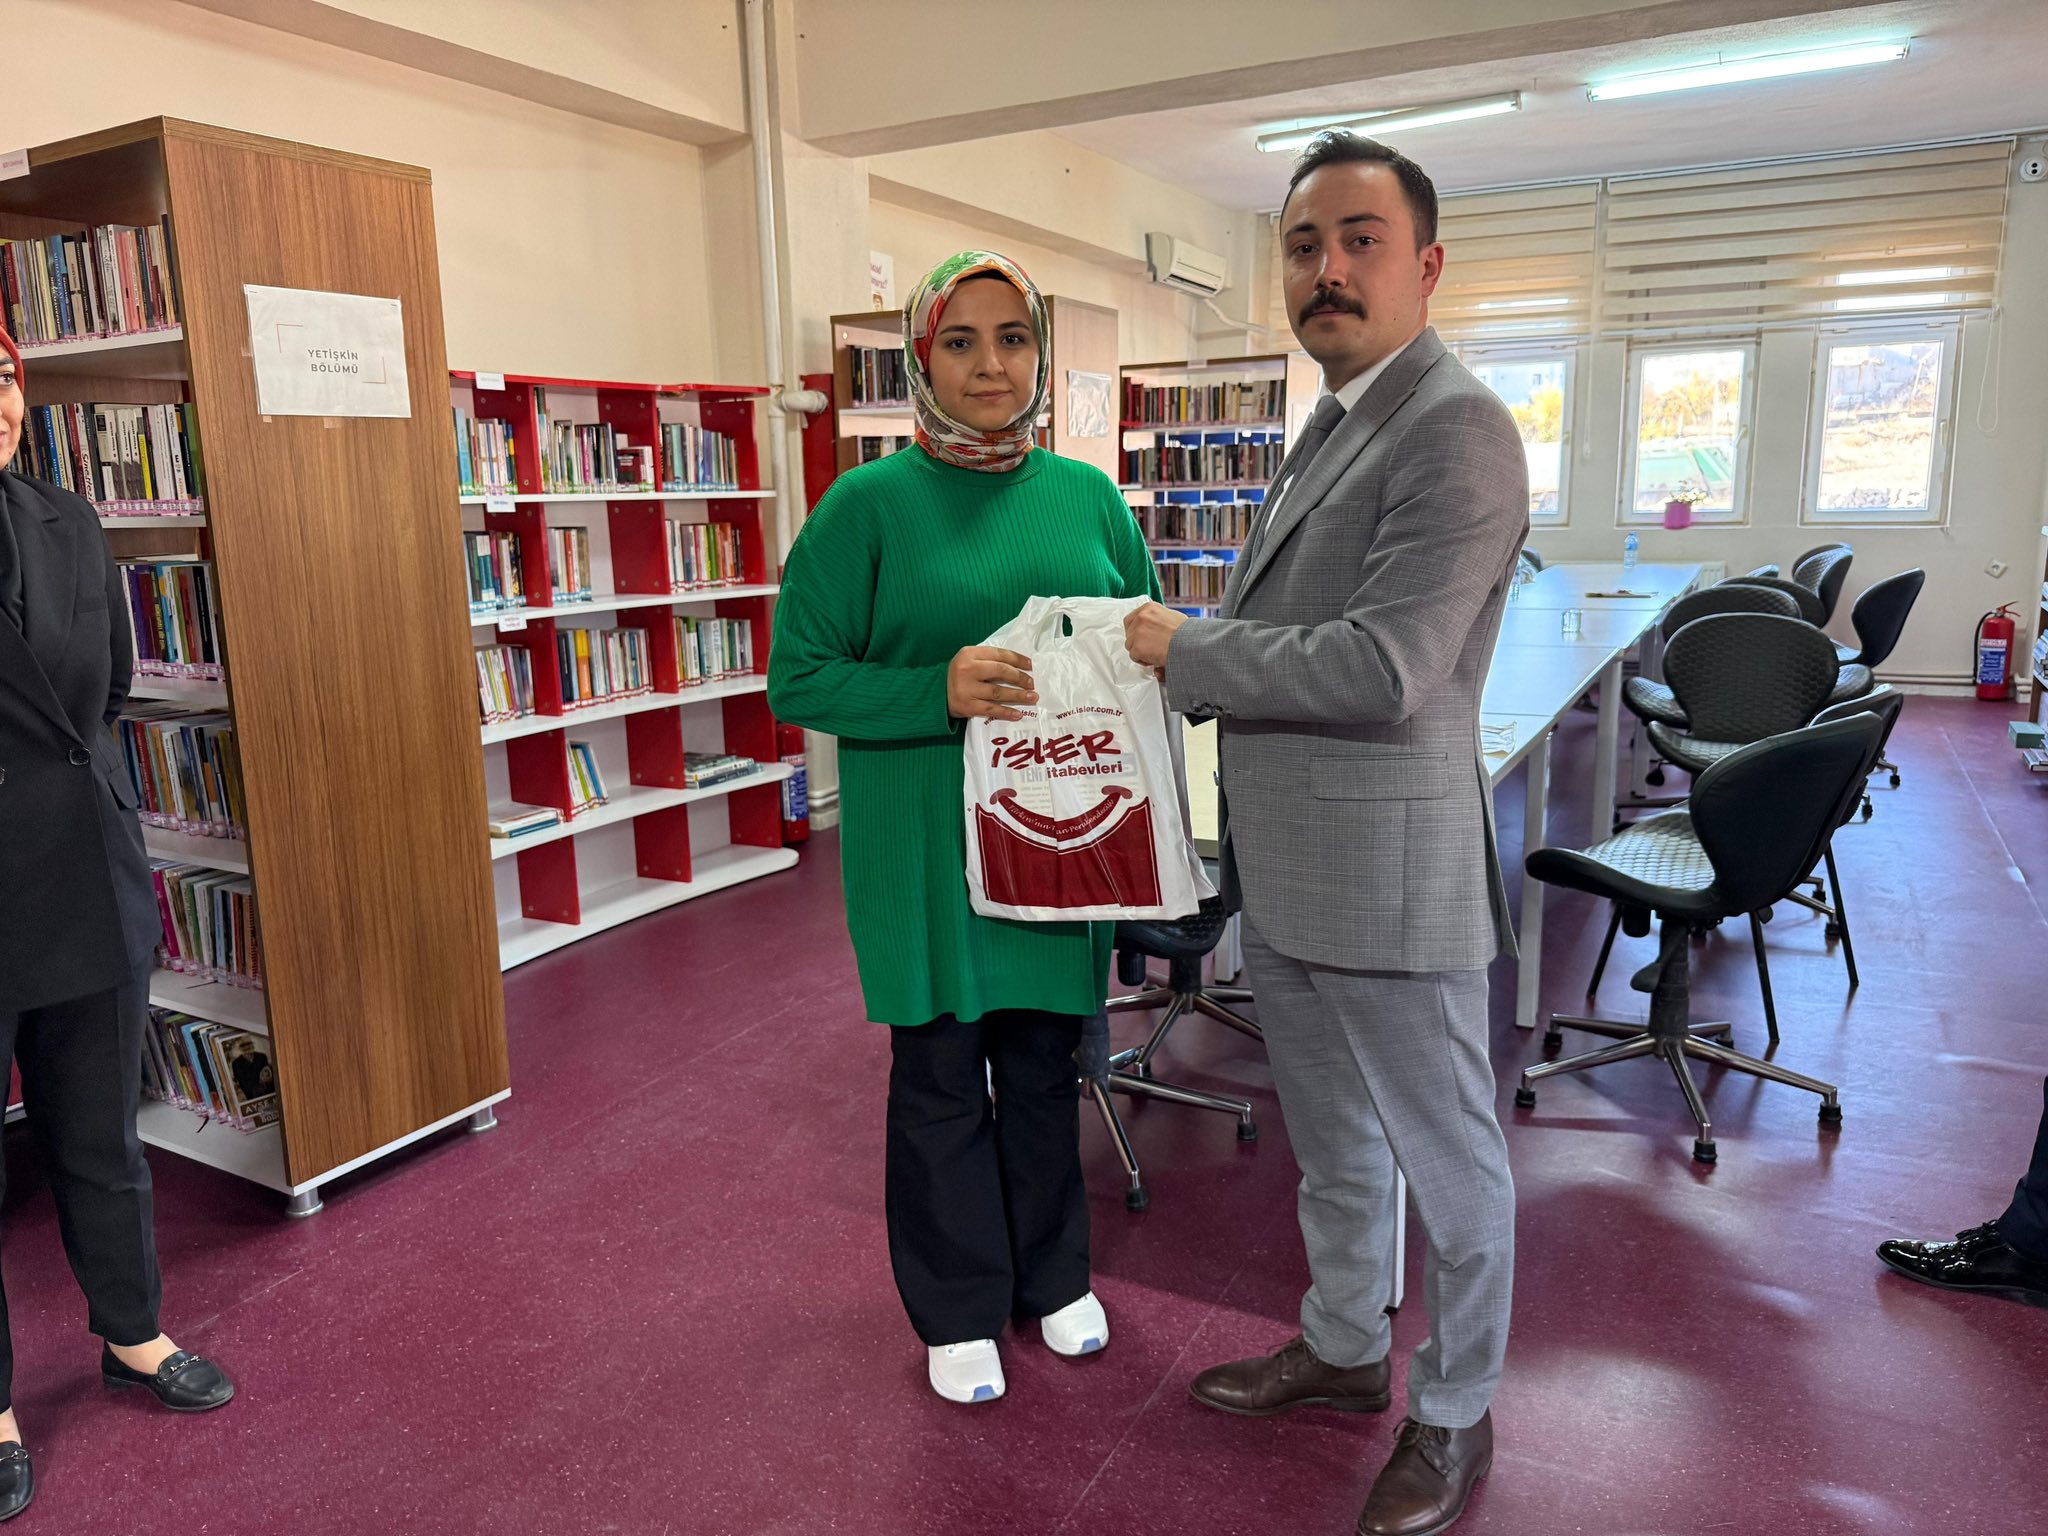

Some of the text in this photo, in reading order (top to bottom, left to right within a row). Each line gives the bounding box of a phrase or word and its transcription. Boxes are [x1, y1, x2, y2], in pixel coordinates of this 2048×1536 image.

[307, 348, 359, 361] YETİŞKİN
[310, 362, 359, 374] BÖLÜMÜ
[1045, 760, 1123, 778] itabevleri
